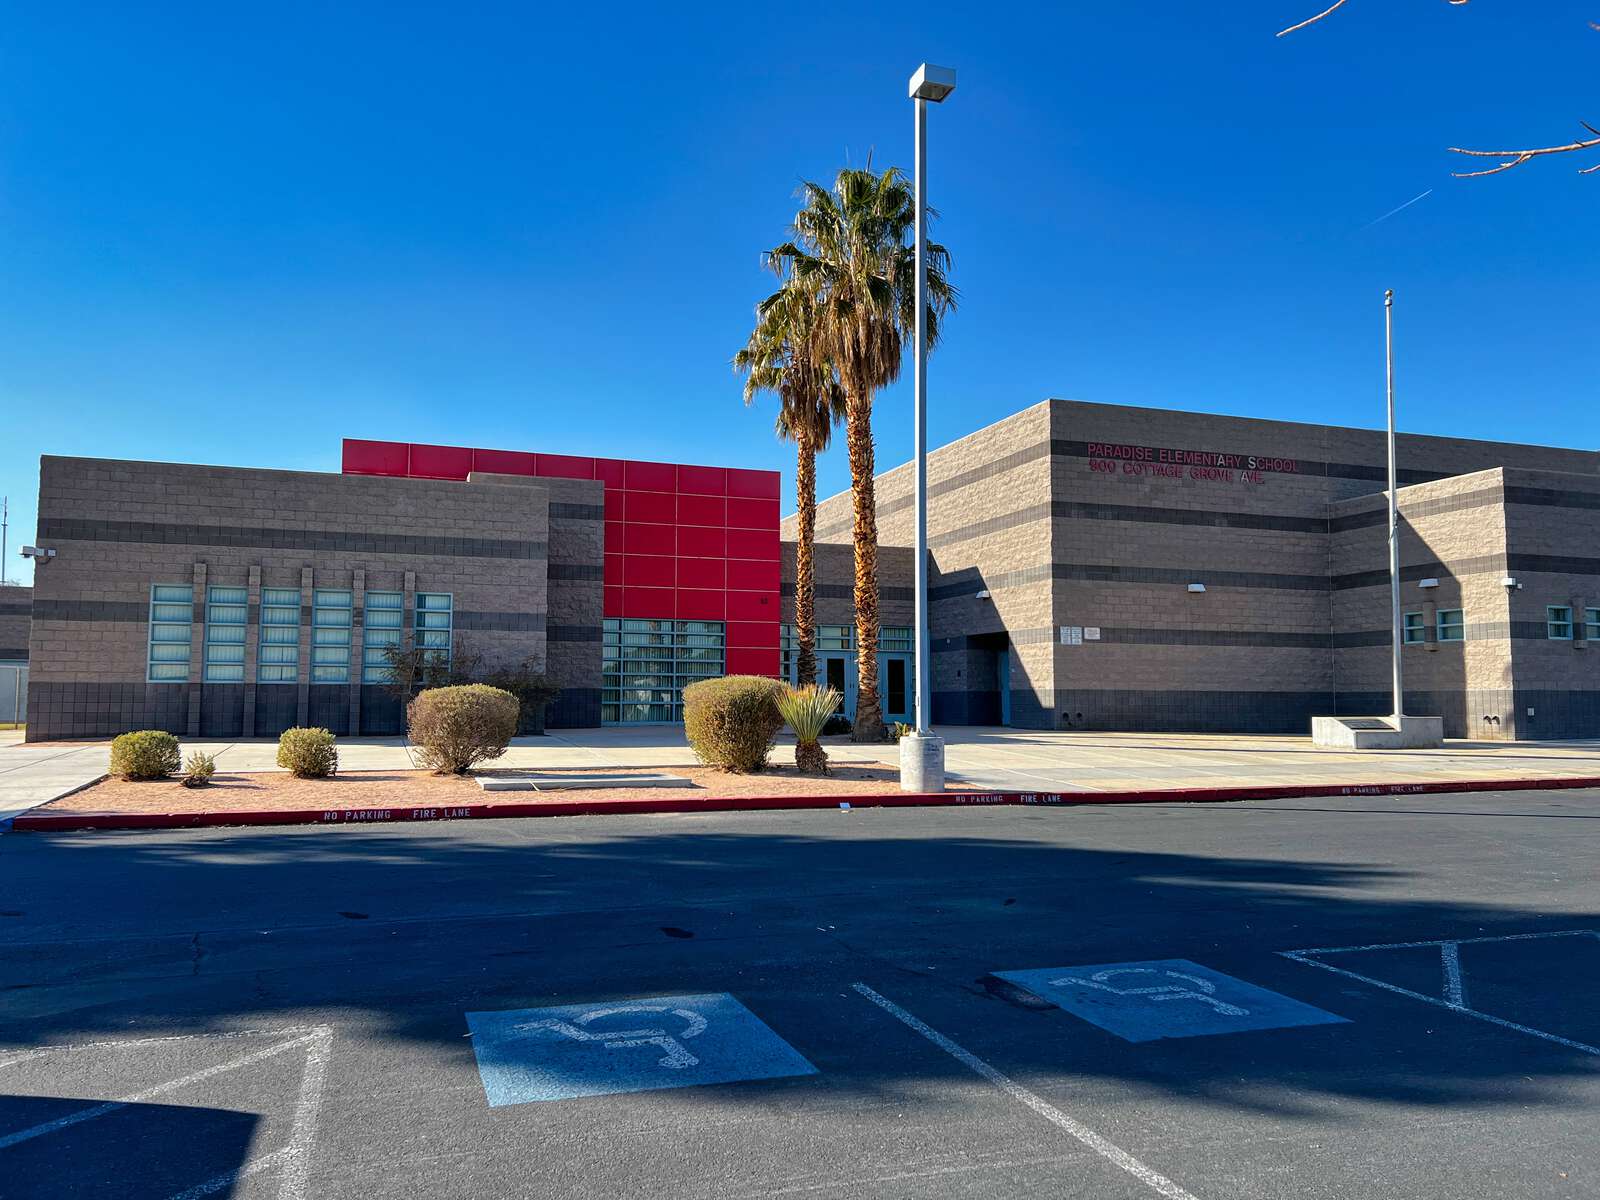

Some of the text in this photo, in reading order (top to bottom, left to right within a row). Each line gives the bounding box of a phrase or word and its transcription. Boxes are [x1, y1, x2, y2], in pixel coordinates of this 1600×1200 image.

[1087, 443, 1299, 472] PARADISE ELEMENTARY SCHOOL
[1122, 461, 1183, 479] COTTAGE
[1189, 466, 1234, 482] GROVE
[1020, 794, 1037, 803] FIRE
[1042, 794, 1061, 803] LANE
[324, 807, 471, 820] NO PARKING FIRE LANE
